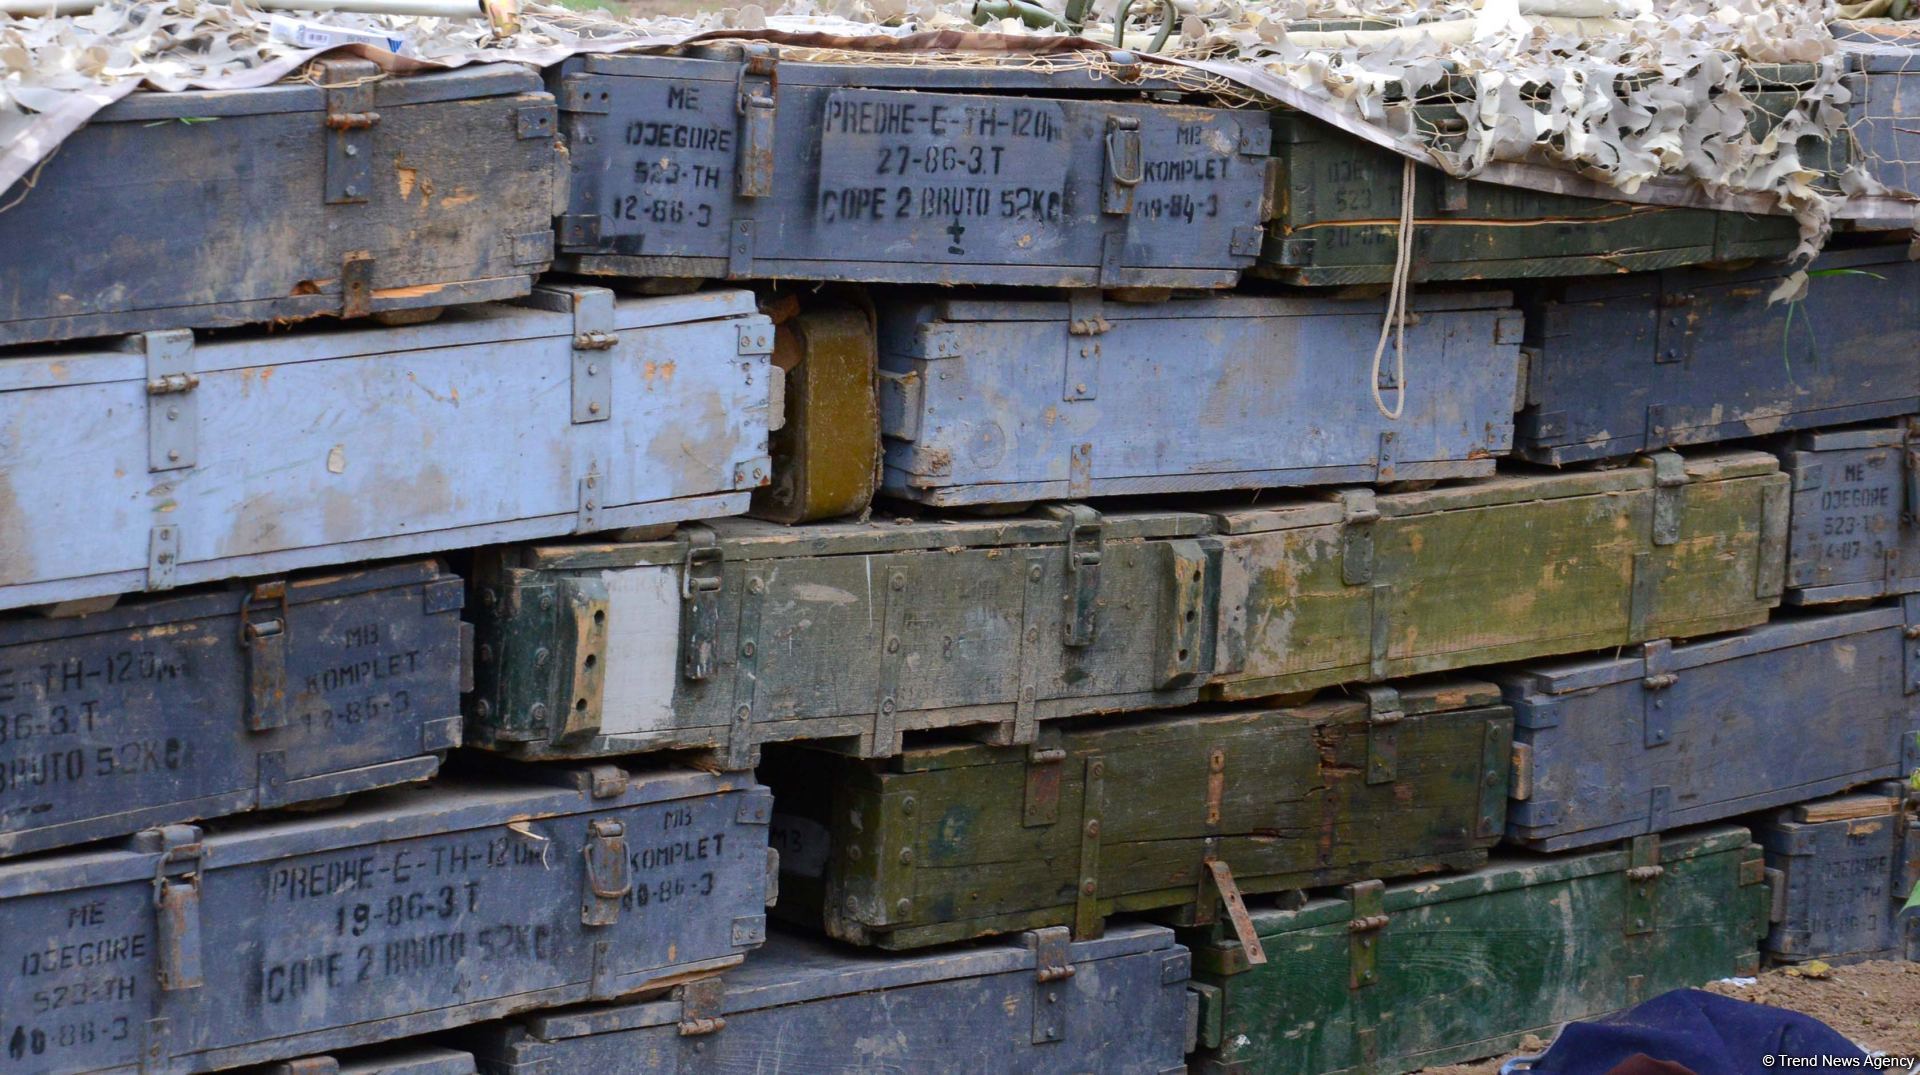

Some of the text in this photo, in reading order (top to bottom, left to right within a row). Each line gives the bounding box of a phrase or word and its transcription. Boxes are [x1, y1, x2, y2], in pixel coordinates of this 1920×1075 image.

[668, 85, 701, 110] ME
[635, 160, 720, 188] 523-TH
[1144, 158, 1229, 182] KOMPLET
[895, 186, 913, 217] 2
[922, 186, 990, 217] BRUTO
[1845, 464, 1864, 481] ME
[303, 650, 417, 694] KOMPLET
[630, 833, 725, 872] KOMPLET
[67, 903, 105, 928] ME
[357, 945, 375, 983] 2
